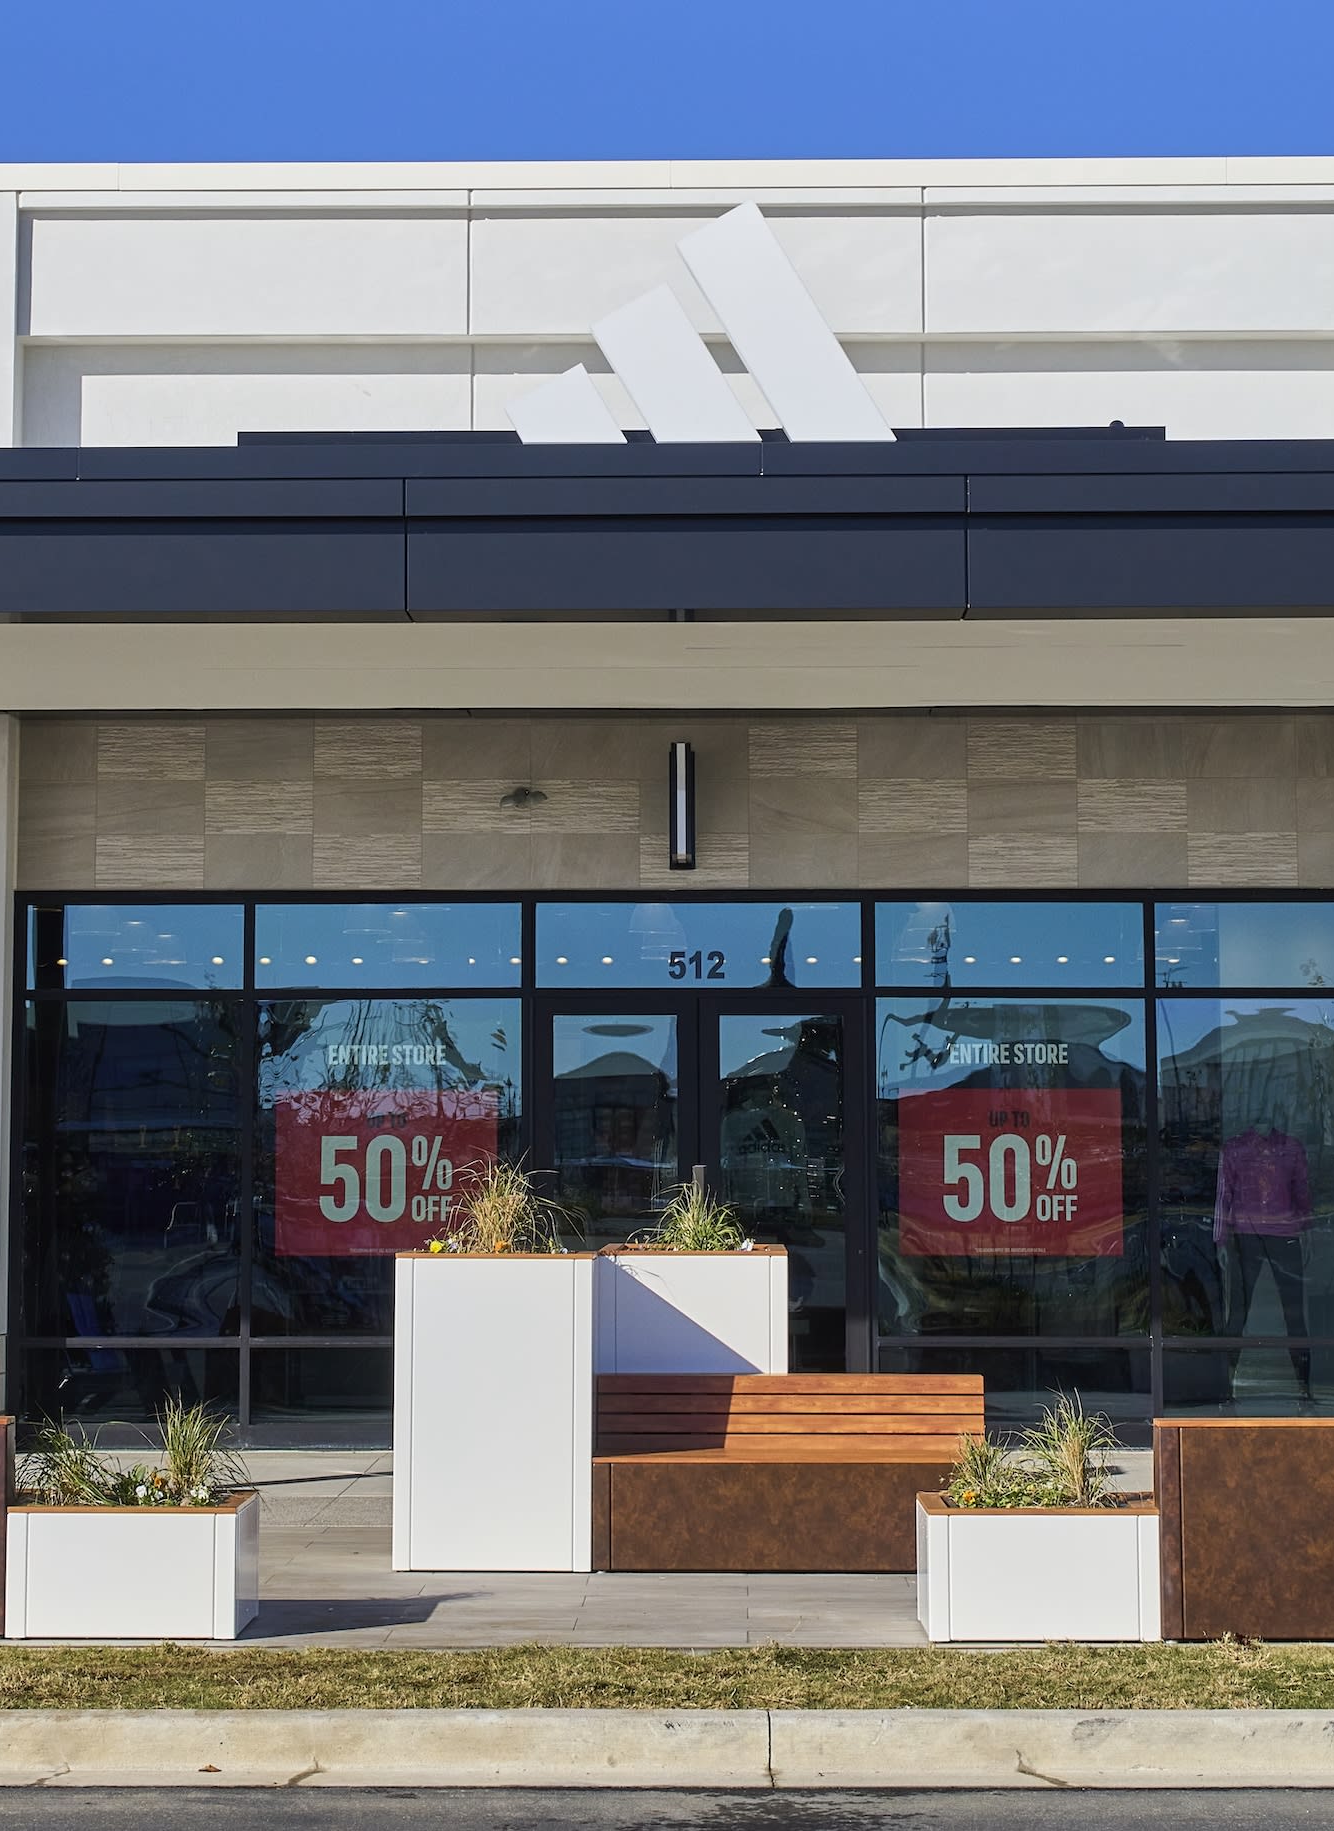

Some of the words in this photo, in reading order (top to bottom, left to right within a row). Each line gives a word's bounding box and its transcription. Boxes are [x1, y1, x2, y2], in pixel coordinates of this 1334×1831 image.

[668, 950, 726, 980] 512
[328, 1044, 389, 1066] ENTIRE
[391, 1044, 447, 1066] STORE
[950, 1043, 1010, 1065] ENTIRE
[1013, 1043, 1069, 1065] STORE
[989, 1111, 1006, 1128] UP
[1011, 1111, 1030, 1128] TO
[319, 1134, 453, 1223] 50%
[943, 1133, 1078, 1223] 50%
[411, 1195, 453, 1223] OFF
[1036, 1195, 1078, 1222] OFF
